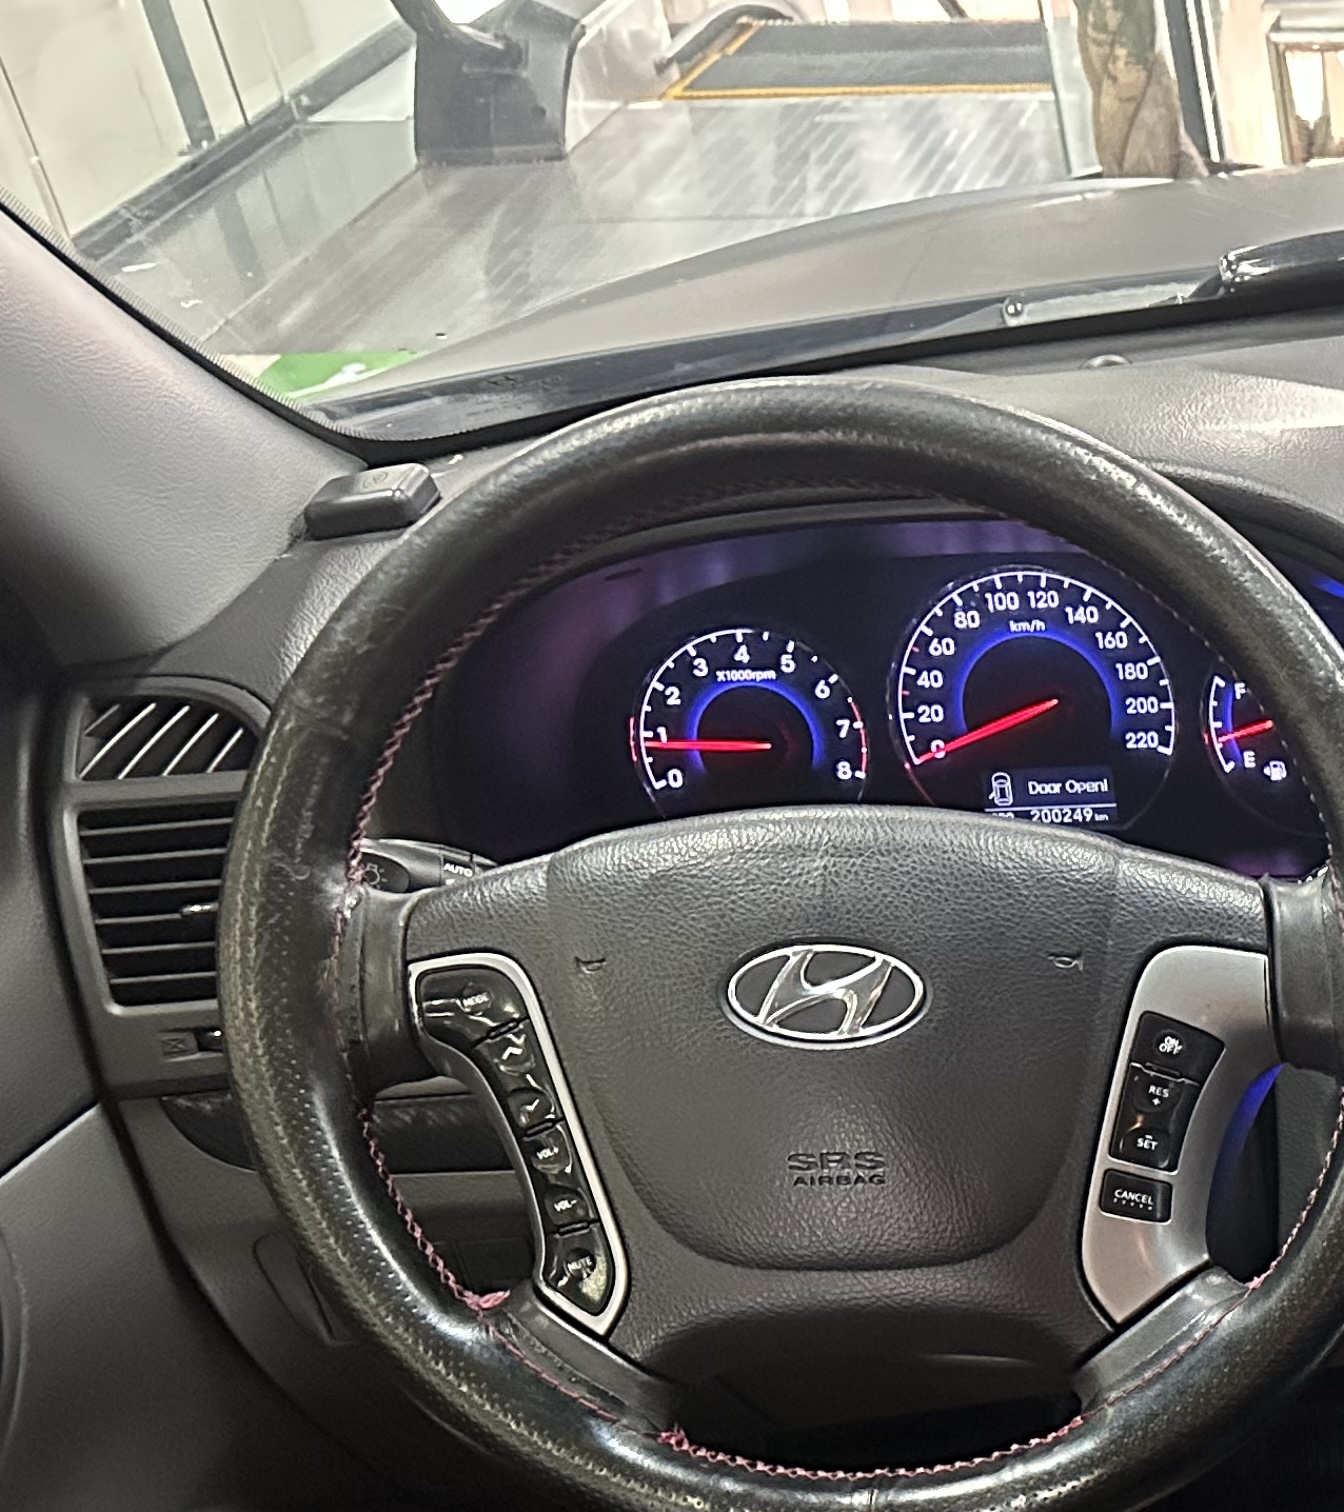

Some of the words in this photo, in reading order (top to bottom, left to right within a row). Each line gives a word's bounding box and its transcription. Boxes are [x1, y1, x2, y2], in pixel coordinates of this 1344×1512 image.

[985, 592, 1019, 613] 100
[1027, 590, 1059, 609] 120
[953, 610, 980, 629] 80
[1064, 605, 1099, 624] 140
[1009, 619, 1046, 633] km/h
[928, 637, 955, 657] 60
[1095, 631, 1128, 650] 160
[734, 645, 750, 663] 4
[693, 658, 708, 677] 3
[780, 654, 796, 673] 5
[1115, 662, 1148, 680] 180
[916, 670, 943, 689] 40
[664, 686, 681, 705] 2
[814, 679, 830, 699] 6
[1234, 682, 1247, 700] F
[917, 704, 944, 723] 20
[1125, 696, 1158, 714] 200
[656, 726, 668, 743] 1
[836, 719, 850, 738] 7
[930, 739, 946, 758] 0
[1125, 731, 1158, 749] 220
[1243, 751, 1256, 768] E
[667, 768, 684, 788] 0
[836, 761, 852, 780] 8
[1027, 781, 1062, 795] Door
[1030, 808, 1093, 823] 200249
[443, 863, 474, 877] AUTO
[463, 992, 489, 1006] MODE
[1159, 1043, 1183, 1055] OFF
[1164, 1036, 1180, 1047] ON
[1149, 1085, 1169, 1098] RES
[1137, 1138, 1159, 1151] SET
[787, 1151, 886, 1172] SRS
[792, 1174, 886, 1187] AIRBAG
[1114, 1189, 1153, 1205] CANCEL
[568, 1256, 592, 1271] MUTE
